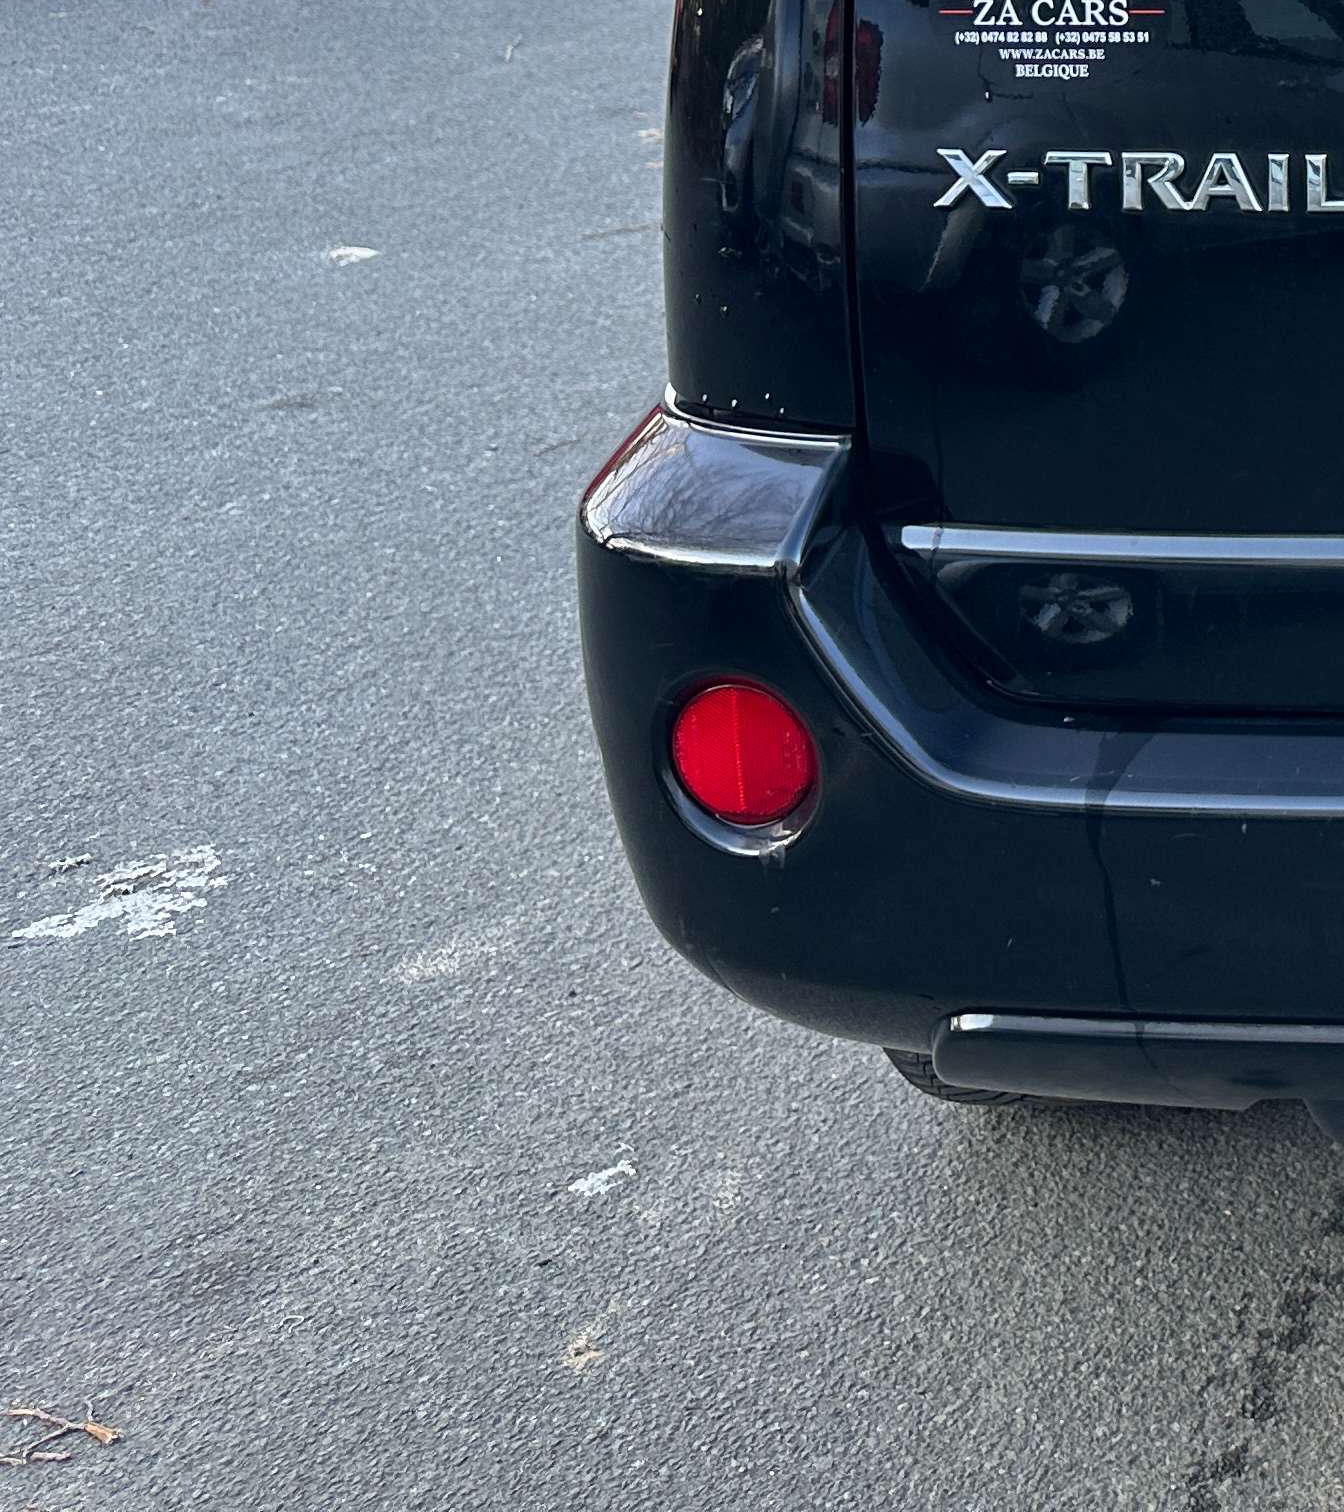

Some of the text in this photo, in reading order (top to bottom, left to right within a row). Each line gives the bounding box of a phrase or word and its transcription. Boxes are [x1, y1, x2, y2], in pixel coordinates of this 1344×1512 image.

[955, 31, 980, 46] (+32)
[981, 31, 1006, 43] 0474
[1055, 31, 1080, 46] (+32)
[1081, 31, 1107, 43] 0475
[1122, 31, 1136, 43] 53
[1136, 31, 1150, 43] 51
[998, 48, 1105, 60] WWW.ZACARS.BE
[1015, 64, 1090, 80] BELGIQUE
